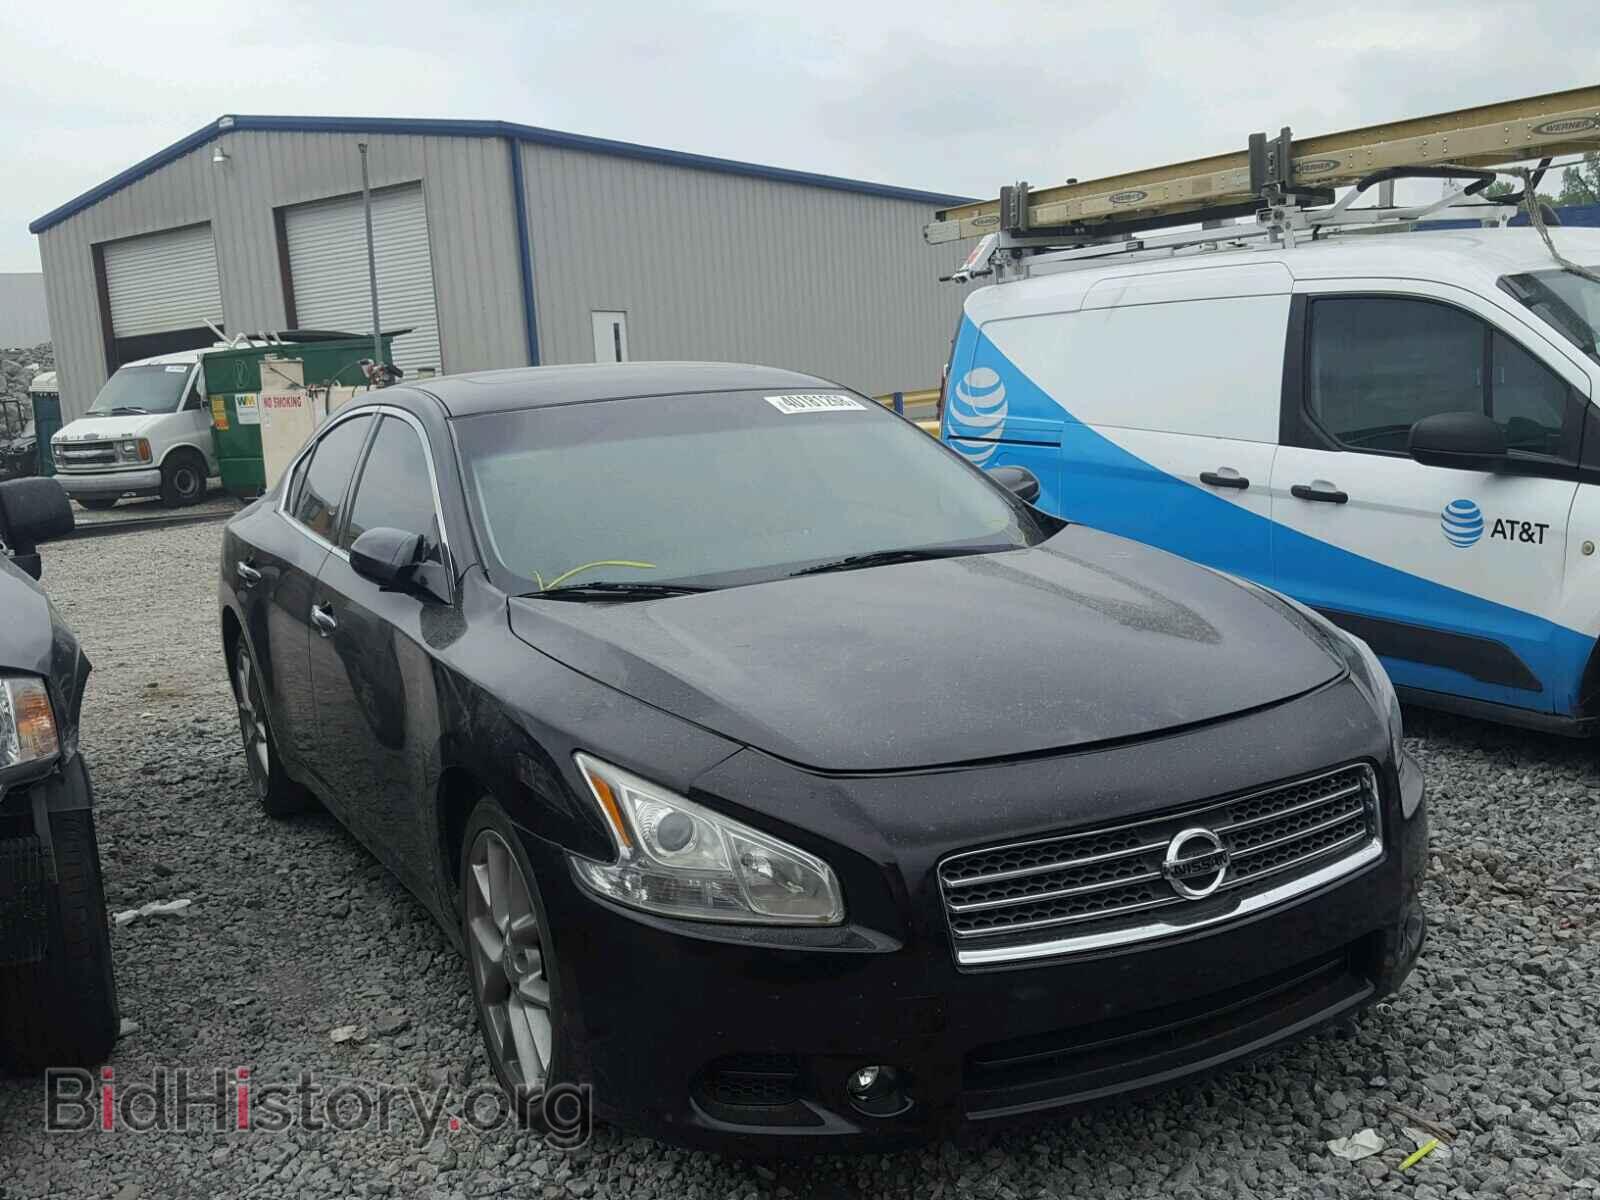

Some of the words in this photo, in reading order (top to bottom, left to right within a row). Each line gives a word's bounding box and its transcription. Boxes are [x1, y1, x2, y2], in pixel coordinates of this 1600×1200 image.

[1545, 119, 1590, 133] WERNER
[273, 396, 302, 408] SMOKING
[1490, 518, 1549, 545] AT&T
